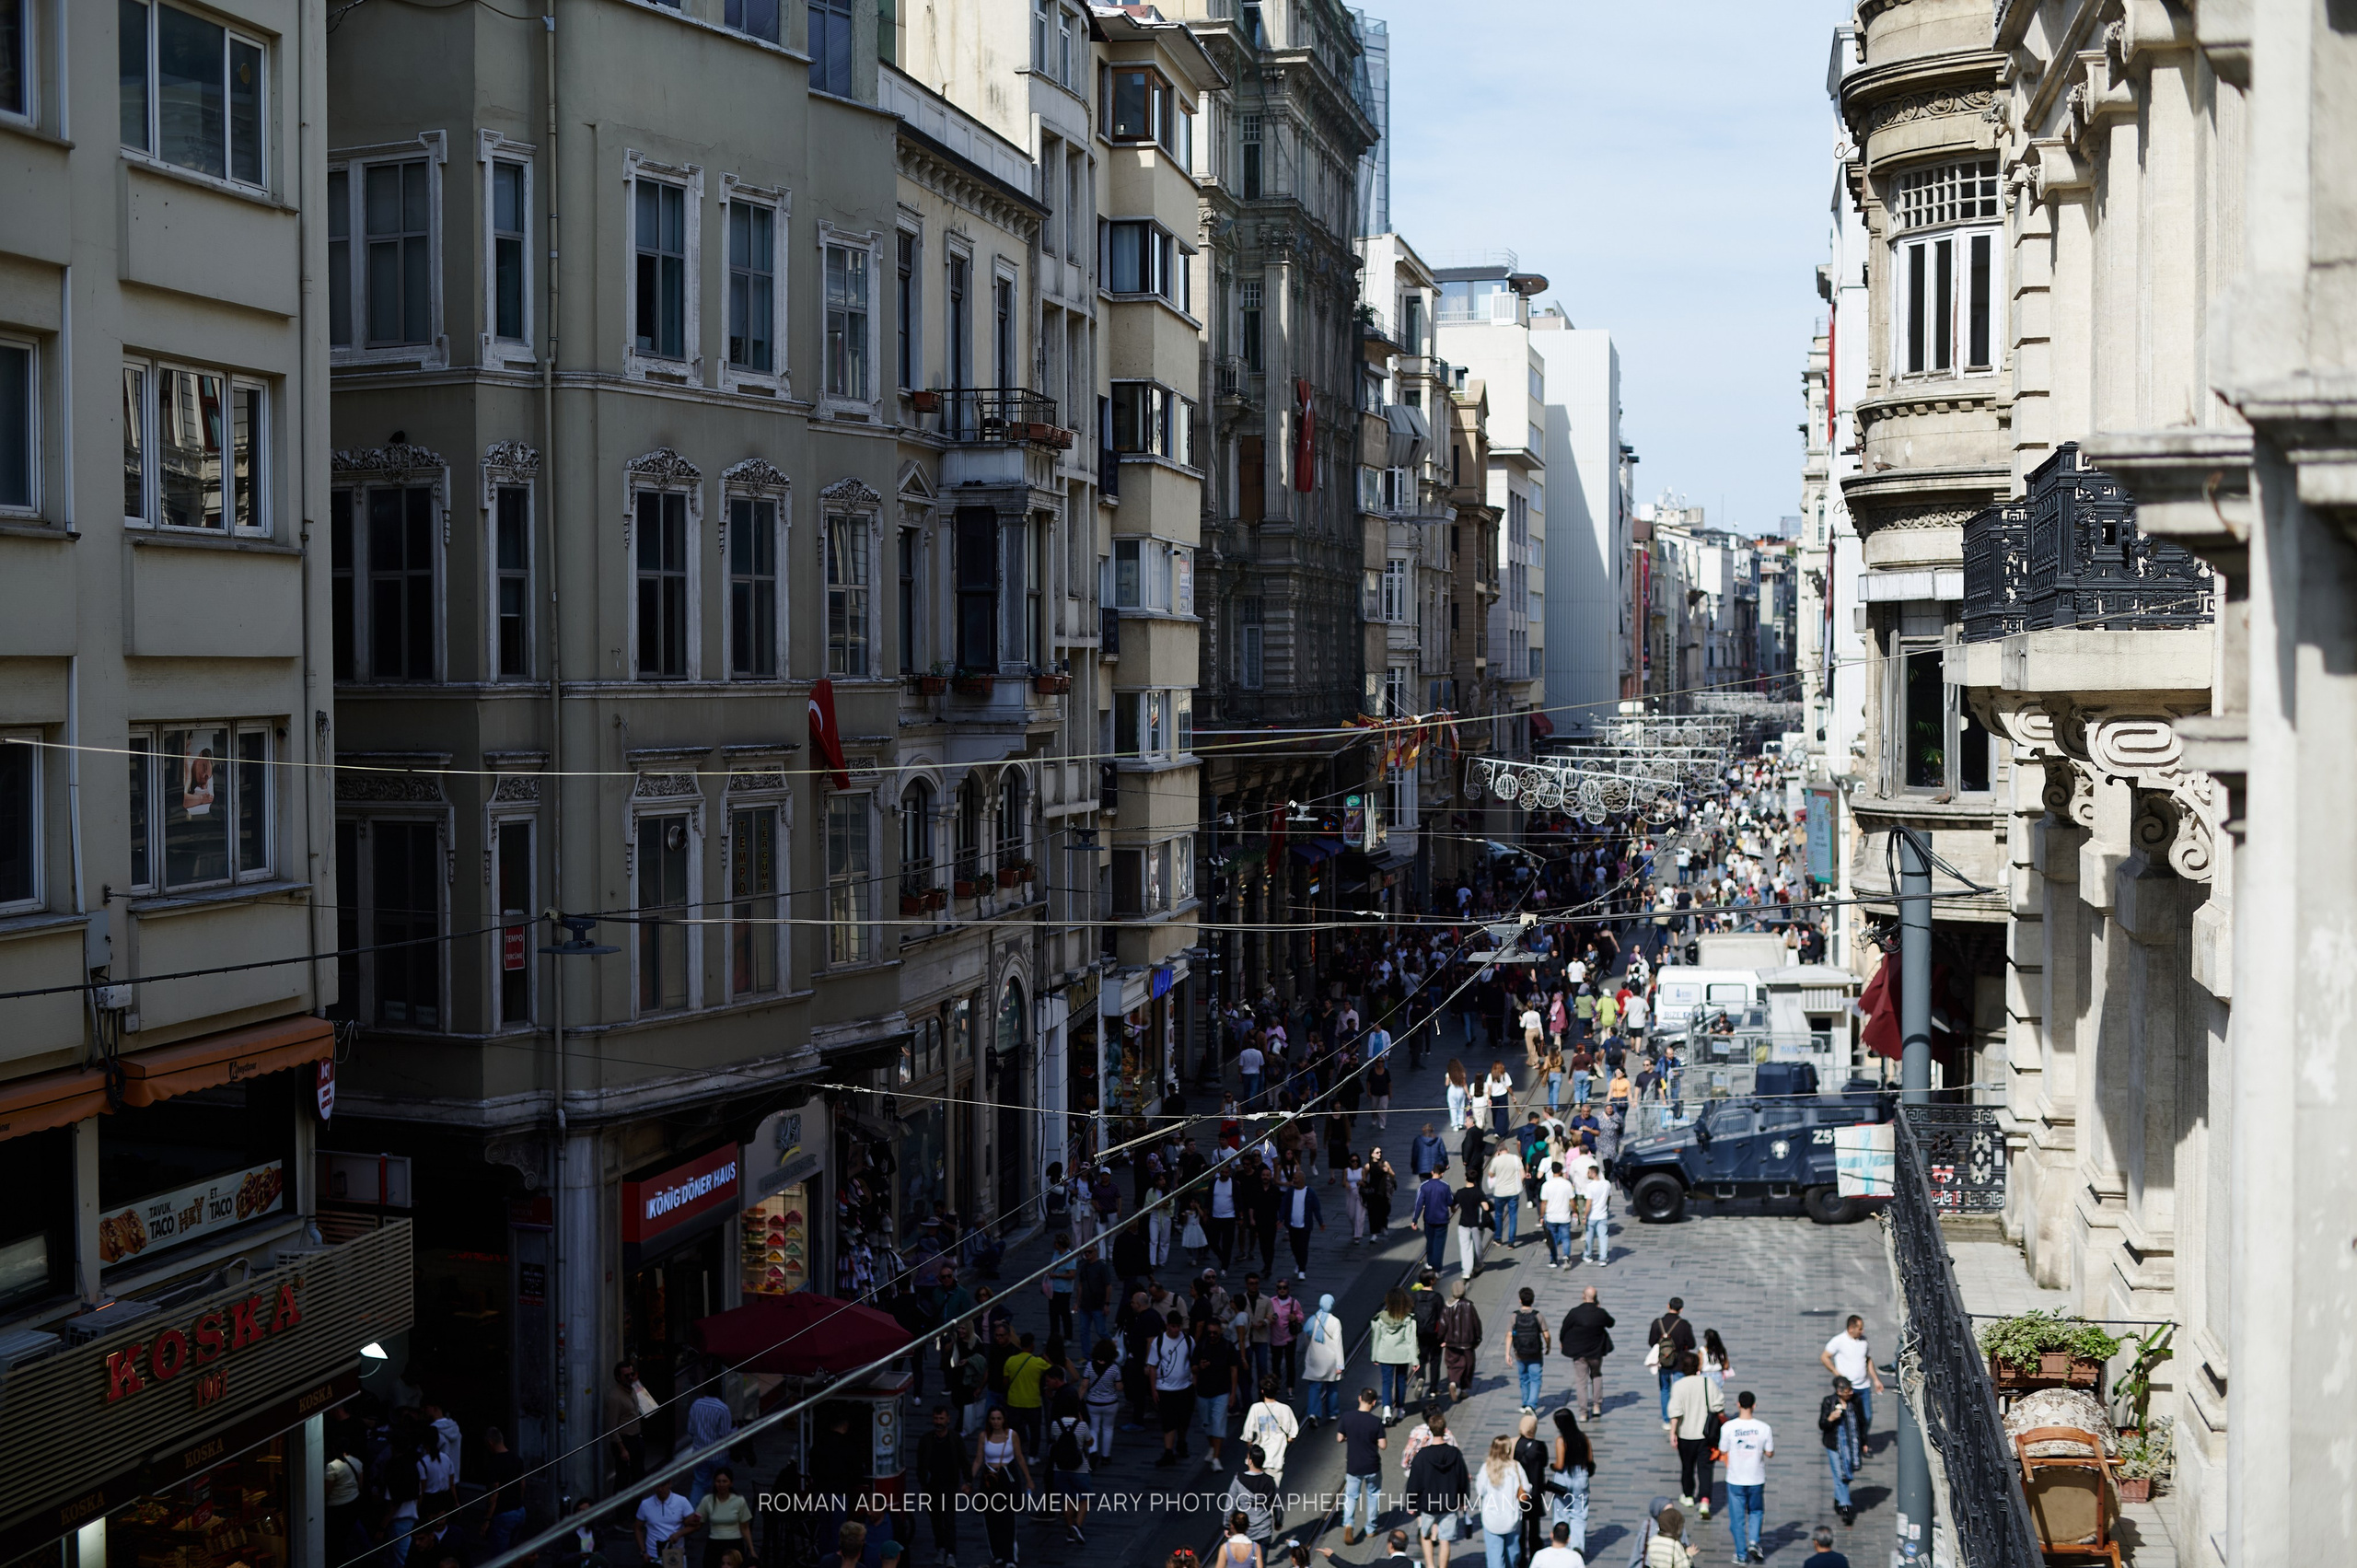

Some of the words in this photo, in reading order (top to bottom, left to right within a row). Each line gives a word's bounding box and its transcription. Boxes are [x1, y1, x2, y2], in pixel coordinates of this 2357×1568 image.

[738, 820, 747, 894] TEMPO
[505, 935, 523, 943] TEMPO
[210, 1188, 217, 1199] ET
[681, 1177, 712, 1204] DÖNER
[714, 1161, 737, 1189] HAUS
[149, 1202, 171, 1218] TAVUK
[178, 1196, 204, 1234] HEY
[209, 1197, 232, 1221] TACO
[149, 1217, 175, 1239] TACO
[105, 1283, 302, 1404] KOSKA
[196, 1369, 228, 1409] 1907
[298, 1384, 333, 1414] KOSKA
[184, 1438, 225, 1470] KOSKA
[60, 1491, 106, 1527] KOSKA
